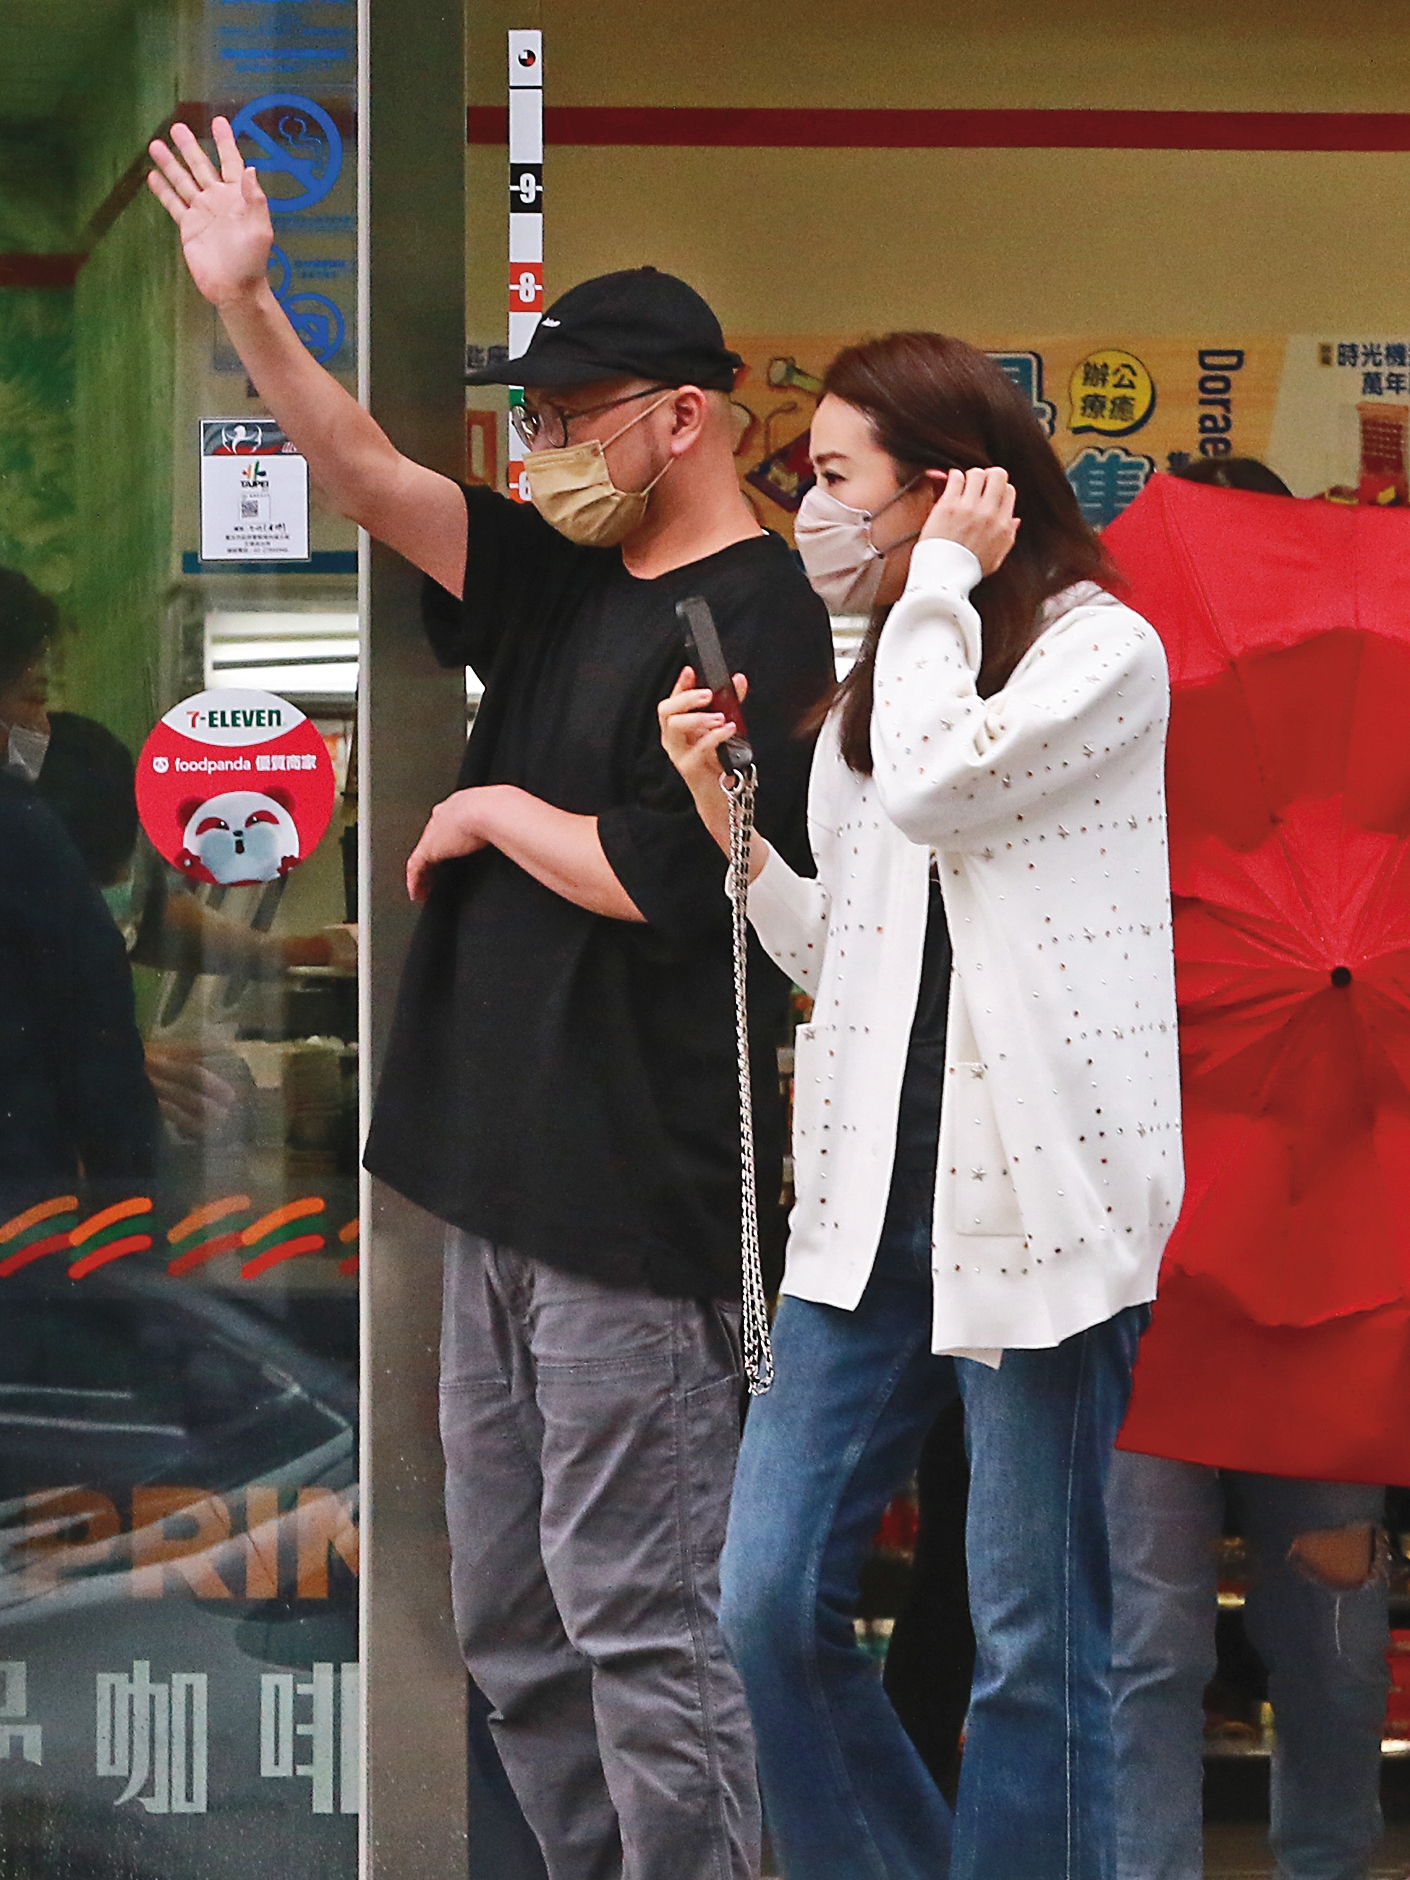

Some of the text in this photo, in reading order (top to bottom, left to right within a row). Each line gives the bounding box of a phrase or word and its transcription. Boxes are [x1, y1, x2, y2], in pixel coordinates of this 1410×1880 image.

[518, 172, 537, 204] 9
[518, 271, 536, 303] 8
[1337, 342, 1410, 367] 時光機
[1361, 371, 1410, 396] 萬年
[1198, 350, 1245, 458] Dorae
[174, 756, 251, 775] foodpanda
